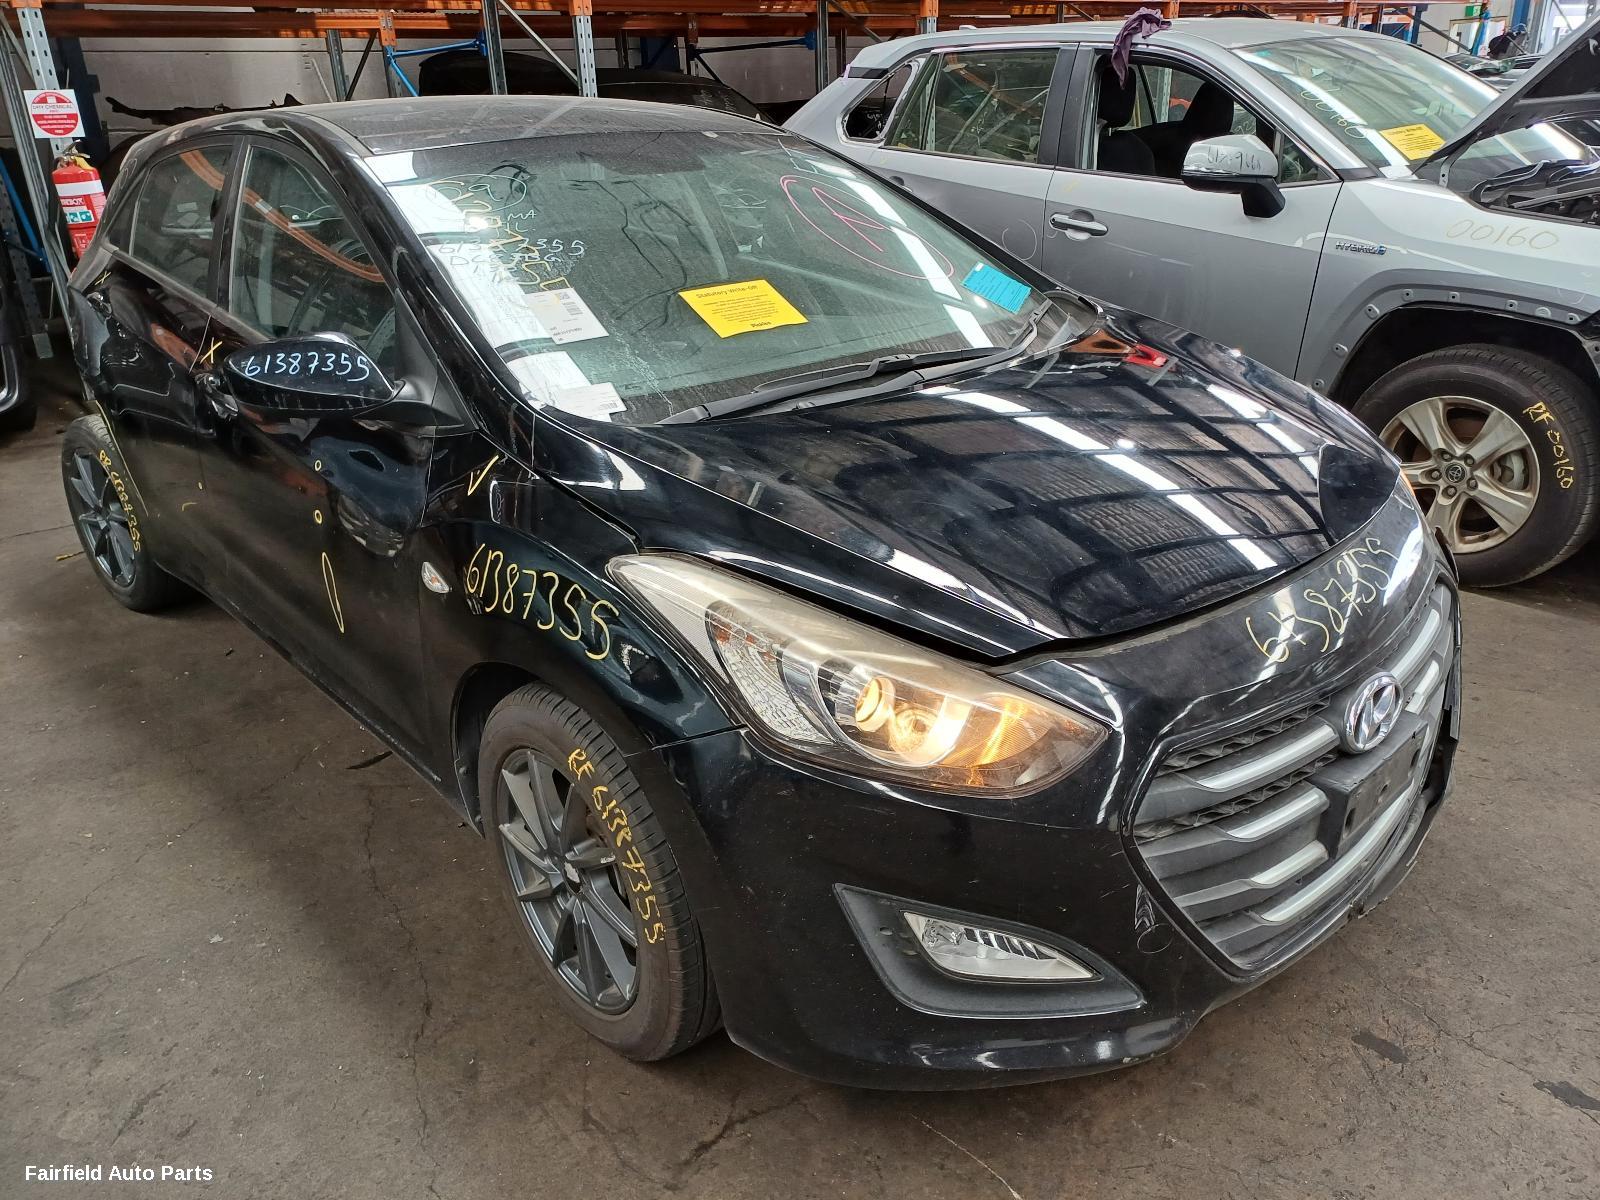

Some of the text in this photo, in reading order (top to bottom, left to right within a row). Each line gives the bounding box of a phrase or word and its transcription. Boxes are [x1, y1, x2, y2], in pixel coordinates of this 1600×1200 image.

[1446, 219, 1560, 250] 00160
[244, 352, 370, 382] 61387355
[466, 543, 620, 660] 61387355
